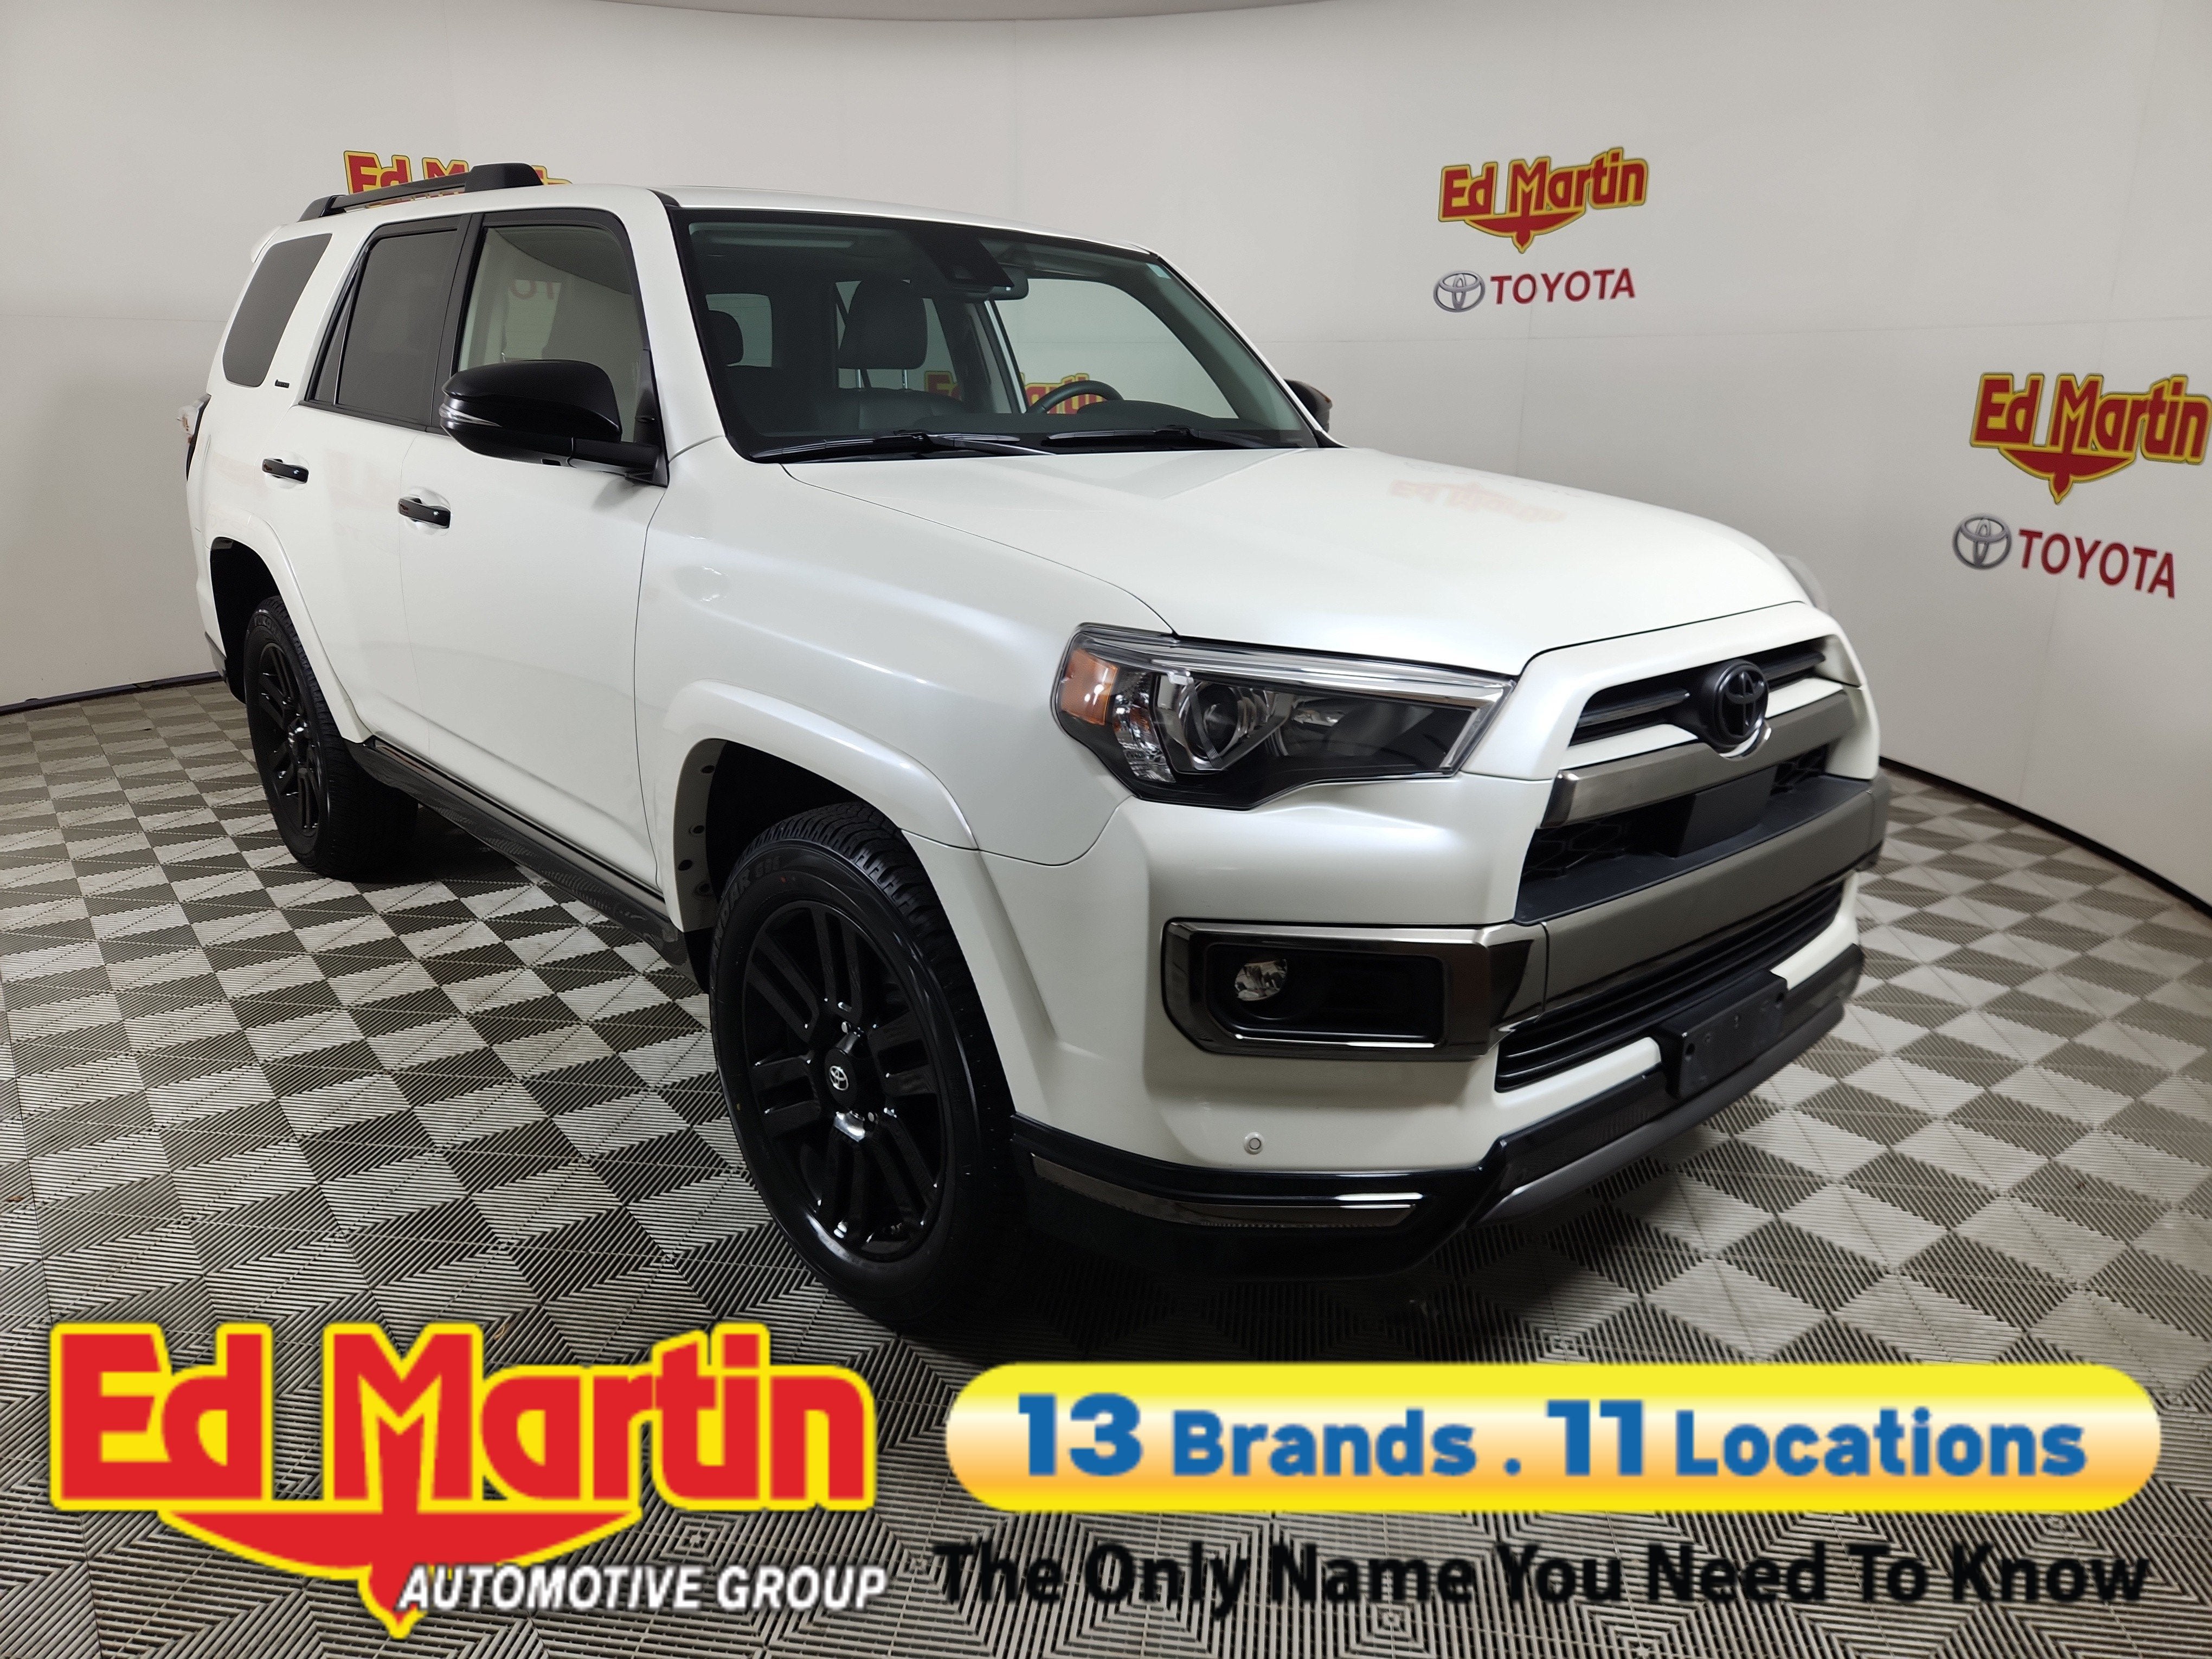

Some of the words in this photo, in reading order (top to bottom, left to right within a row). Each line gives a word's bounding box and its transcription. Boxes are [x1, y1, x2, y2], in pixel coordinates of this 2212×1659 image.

[1439, 163, 1497, 221] Ed
[1504, 147, 1648, 218] Martin
[1490, 268, 1635, 304] TOYOTA
[1971, 373, 2044, 447] Ed
[2046, 373, 2212, 465] Martin
[2018, 528, 2175, 598] TOYOTA
